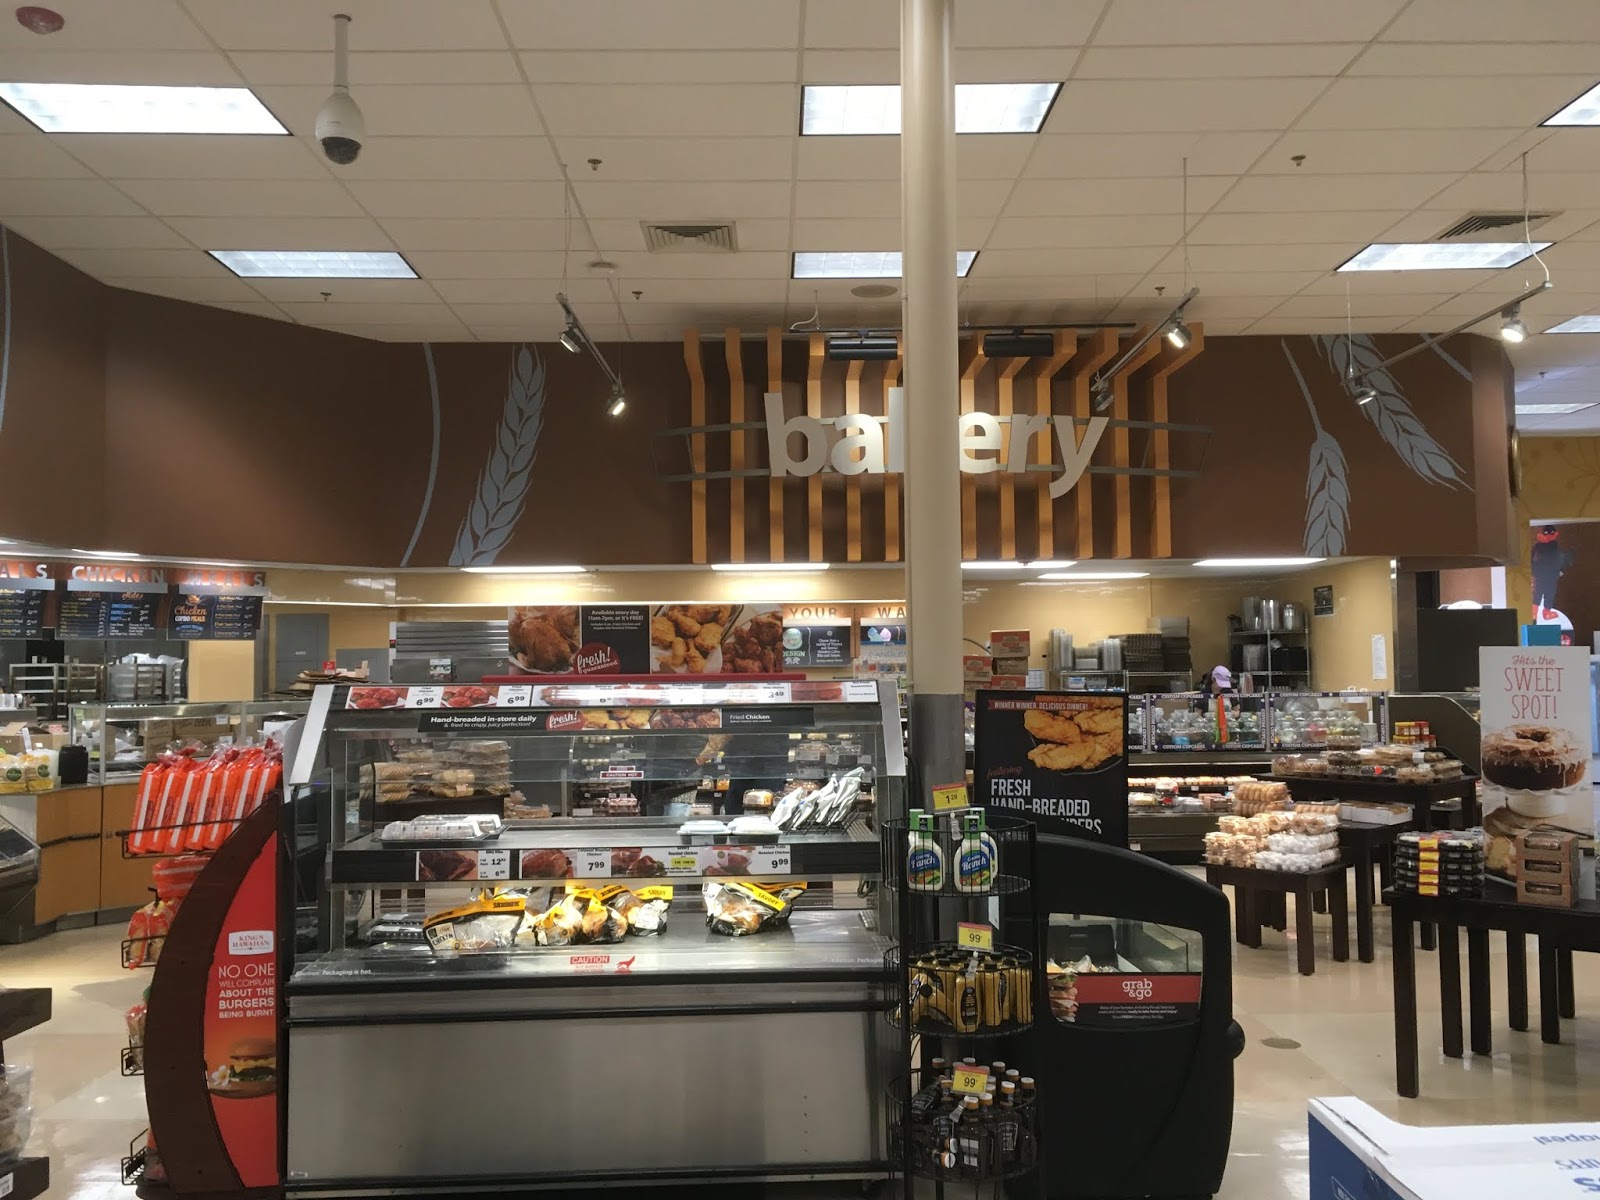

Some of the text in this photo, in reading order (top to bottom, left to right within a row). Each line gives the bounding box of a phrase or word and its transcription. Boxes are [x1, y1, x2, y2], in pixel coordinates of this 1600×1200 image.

[71, 565, 165, 583] CHICKEN
[186, 569, 263, 587] MEALS
[174, 605, 208, 615] Chicken
[789, 607, 837, 618] YOUR
[578, 646, 610, 674] fresh!
[1512, 656, 1556, 666] Hits the
[583, 660, 618, 674] guaranteed
[1504, 667, 1564, 692] SWEET
[1512, 695, 1557, 719] SPOT!
[518, 715, 537, 723] daily
[549, 710, 578, 728] fresh!
[990, 778, 1031, 796] FRESH
[588, 862, 605, 871] 799
[771, 858, 788, 868] 999
[962, 857, 986, 870] Ranch
[758, 892, 778, 905] SAVORY
[239, 934, 264, 942] KING'S
[232, 940, 270, 948] HAWAIIAN
[572, 956, 608, 964] CAUTION
[218, 962, 274, 978] NO ONE
[236, 978, 274, 987] COMPLAIN
[1122, 978, 1152, 992] grab
[219, 987, 274, 998] ABOUT THE
[1129, 989, 1152, 1000] &go
[219, 998, 274, 1010] BURGERS
[219, 1009, 273, 1018] BEING BURNT
